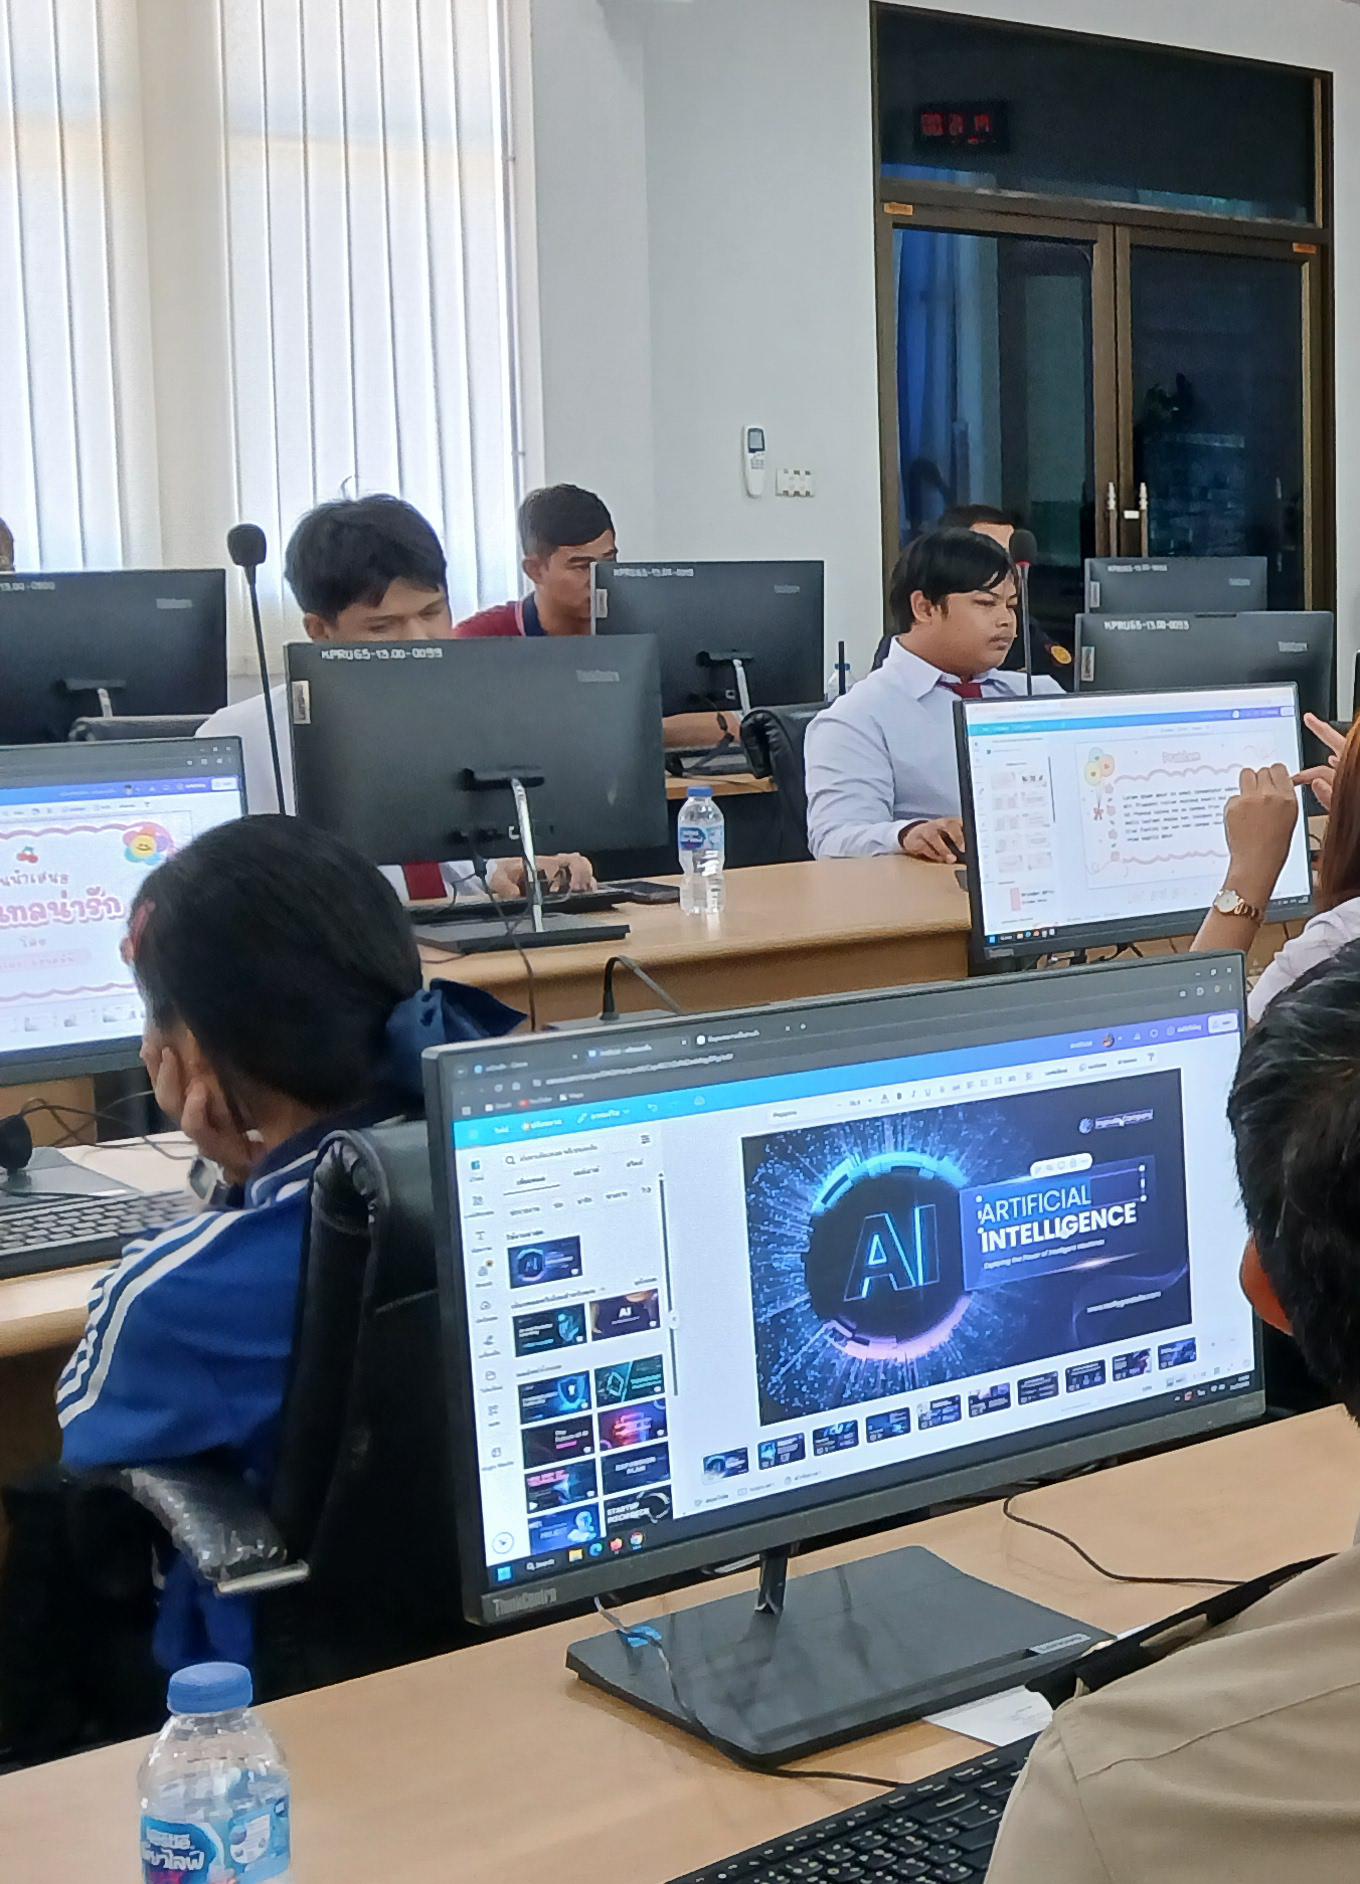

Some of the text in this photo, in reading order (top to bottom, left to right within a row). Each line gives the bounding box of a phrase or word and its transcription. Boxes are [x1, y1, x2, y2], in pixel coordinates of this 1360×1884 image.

[981, 1185, 1092, 1225] ARTIFICIAL
[981, 1203, 1138, 1254] INTELLIGENCE
[843, 1203, 941, 1302] AI
